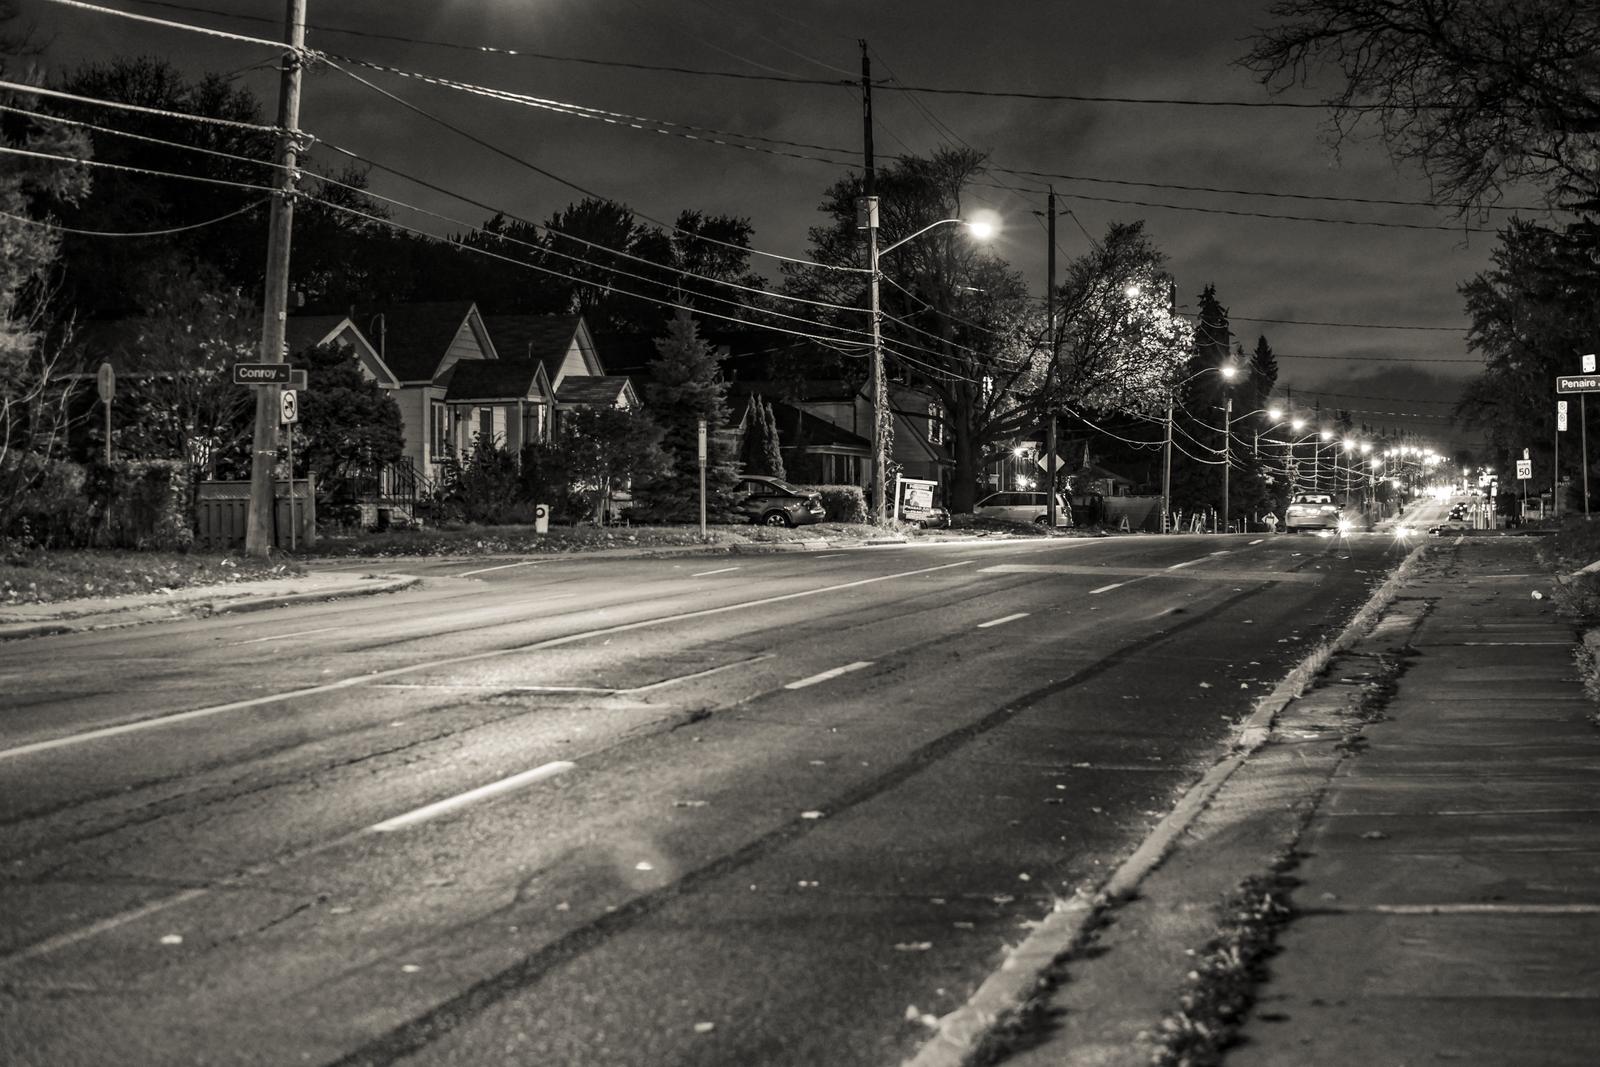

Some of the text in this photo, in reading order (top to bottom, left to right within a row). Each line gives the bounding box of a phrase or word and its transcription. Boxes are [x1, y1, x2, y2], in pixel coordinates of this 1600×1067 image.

[239, 368, 277, 379] Conroy
[1562, 379, 1596, 389] Penaire
[1519, 467, 1530, 476] 50
